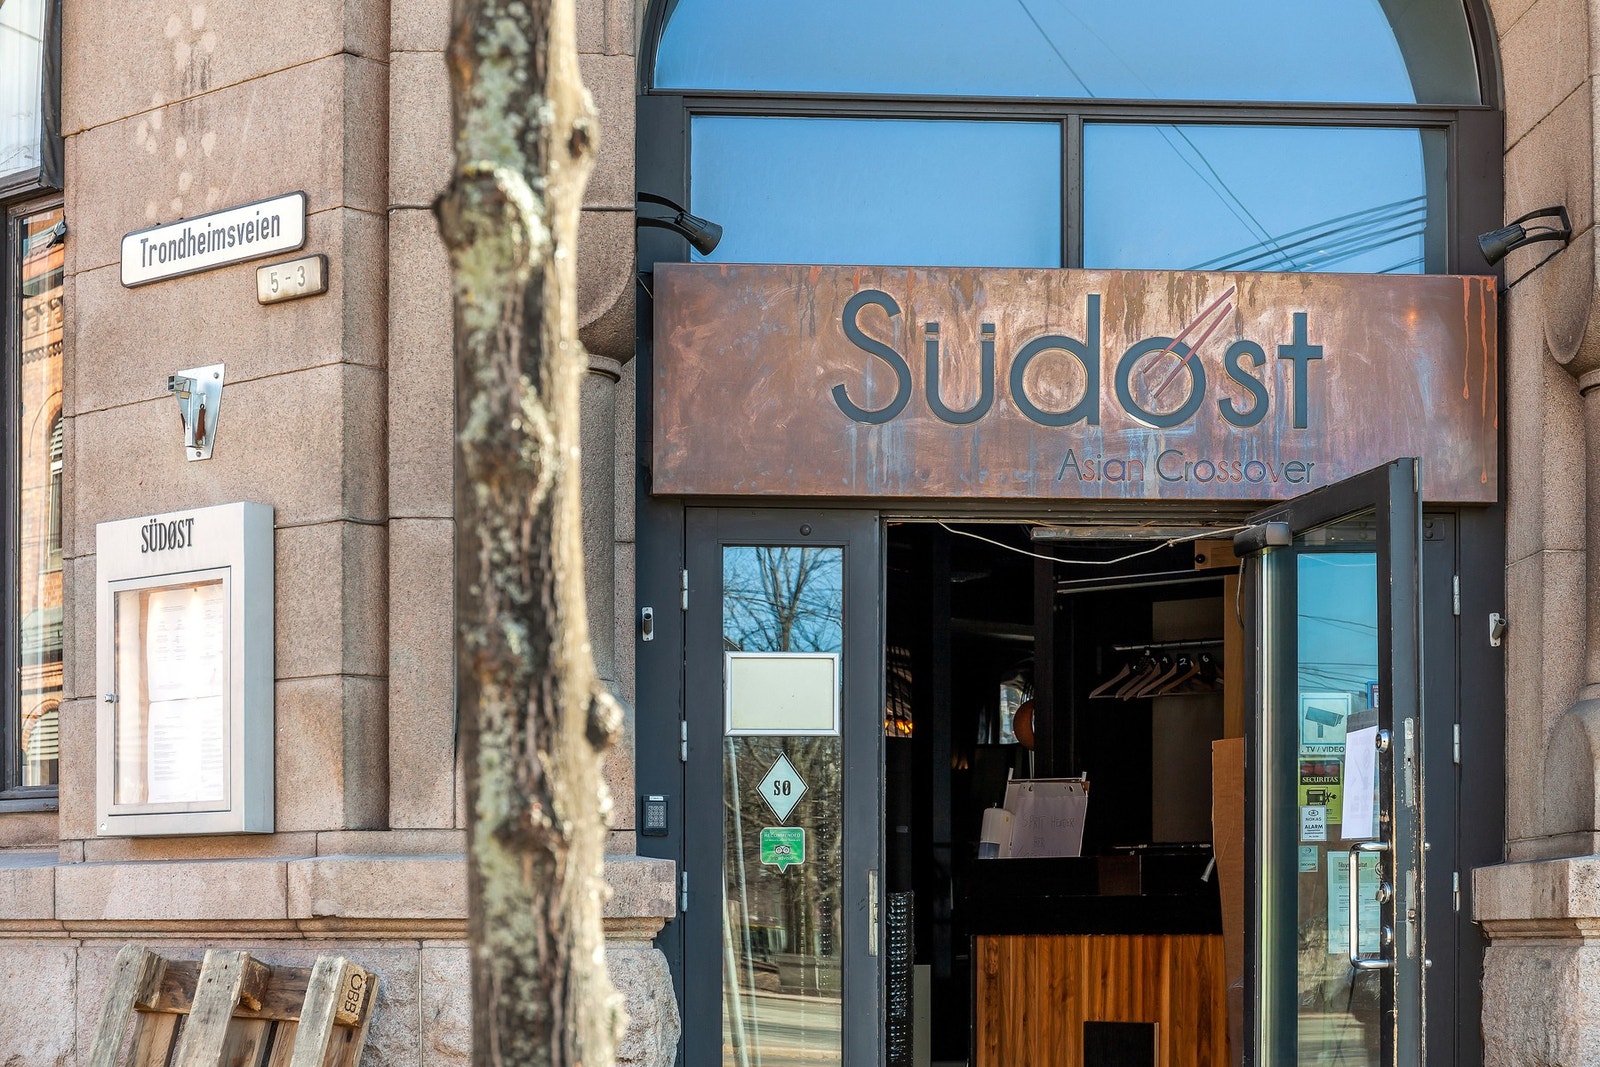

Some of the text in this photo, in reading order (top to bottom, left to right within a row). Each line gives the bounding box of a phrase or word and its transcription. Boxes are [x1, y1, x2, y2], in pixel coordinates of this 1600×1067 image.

[140, 211, 281, 268] Trondheimsveien
[1057, 448, 1316, 485] Asian Crossover
[141, 517, 195, 554] SÜDØST
[1179, 657, 1188, 666] 2
[1202, 655, 1210, 663] 6
